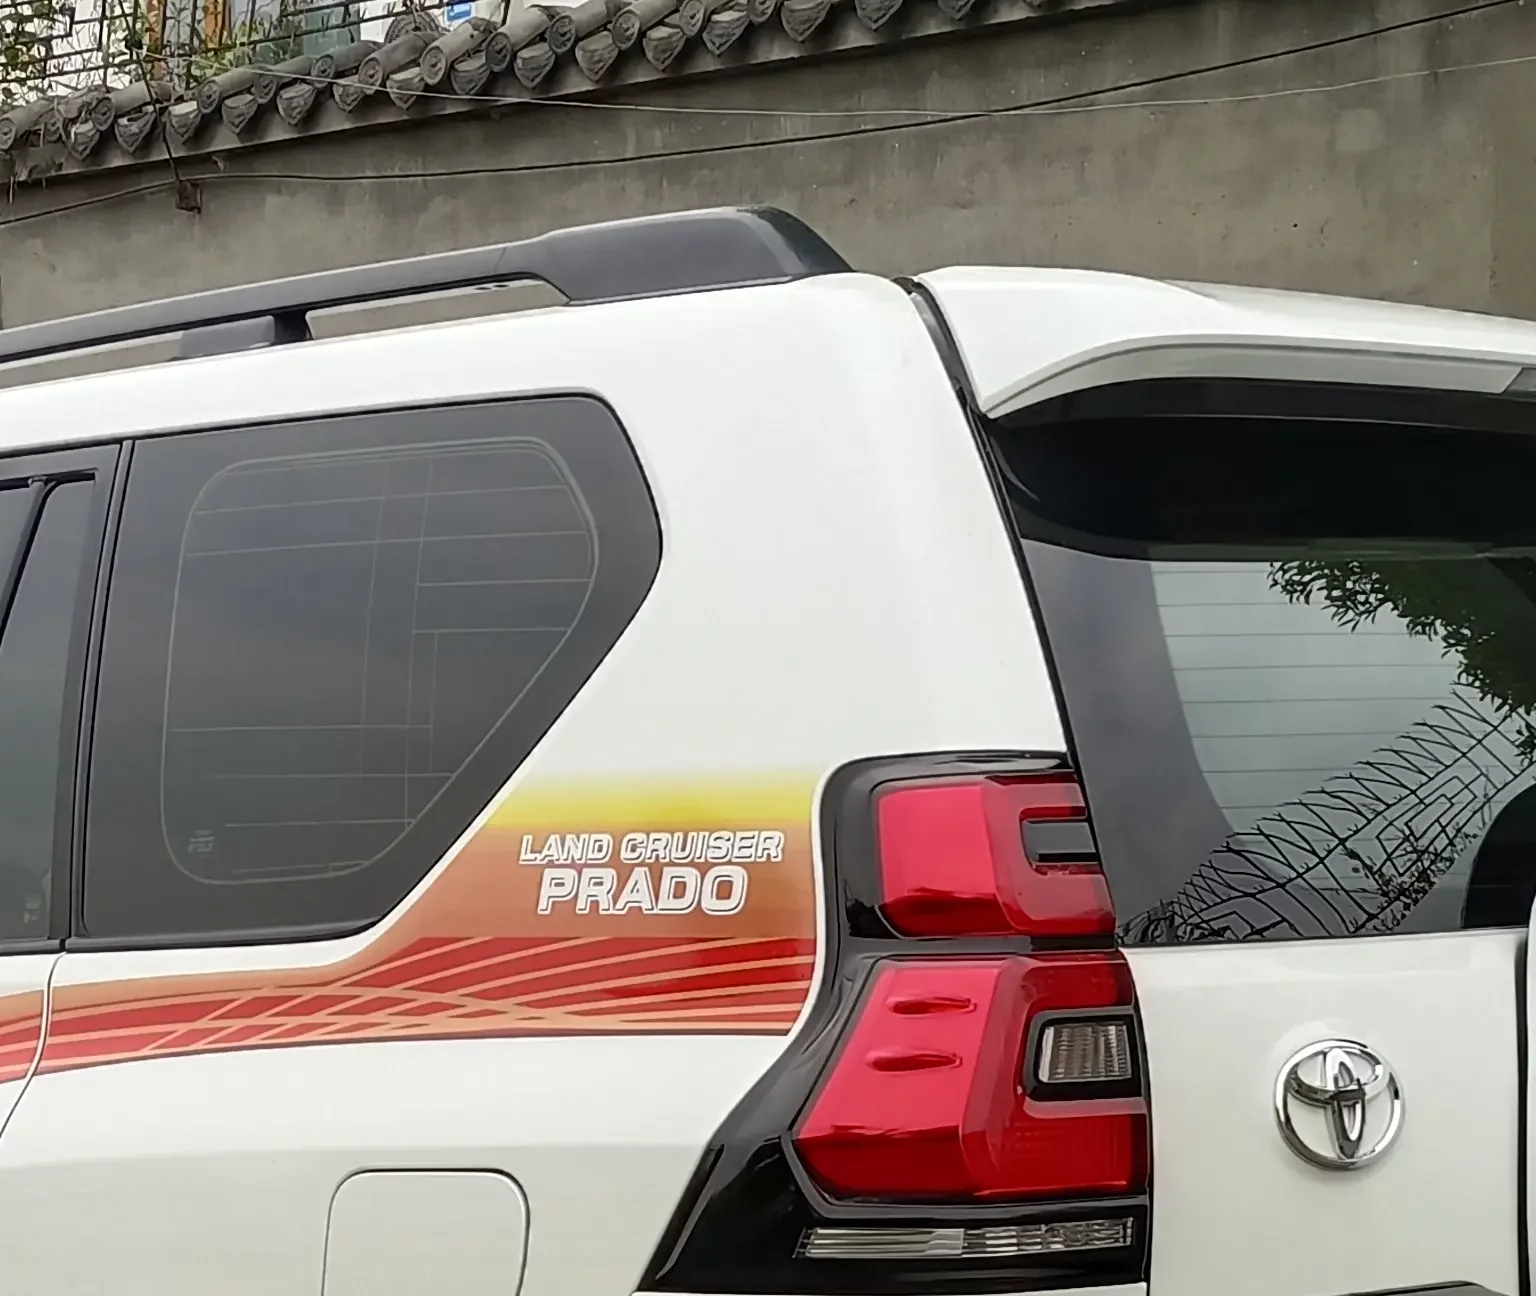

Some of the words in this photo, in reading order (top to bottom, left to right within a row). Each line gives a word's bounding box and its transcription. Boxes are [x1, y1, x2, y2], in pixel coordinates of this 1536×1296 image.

[519, 834, 613, 864] LAND
[620, 831, 785, 863] CRUISER
[537, 866, 749, 916] PRADO
